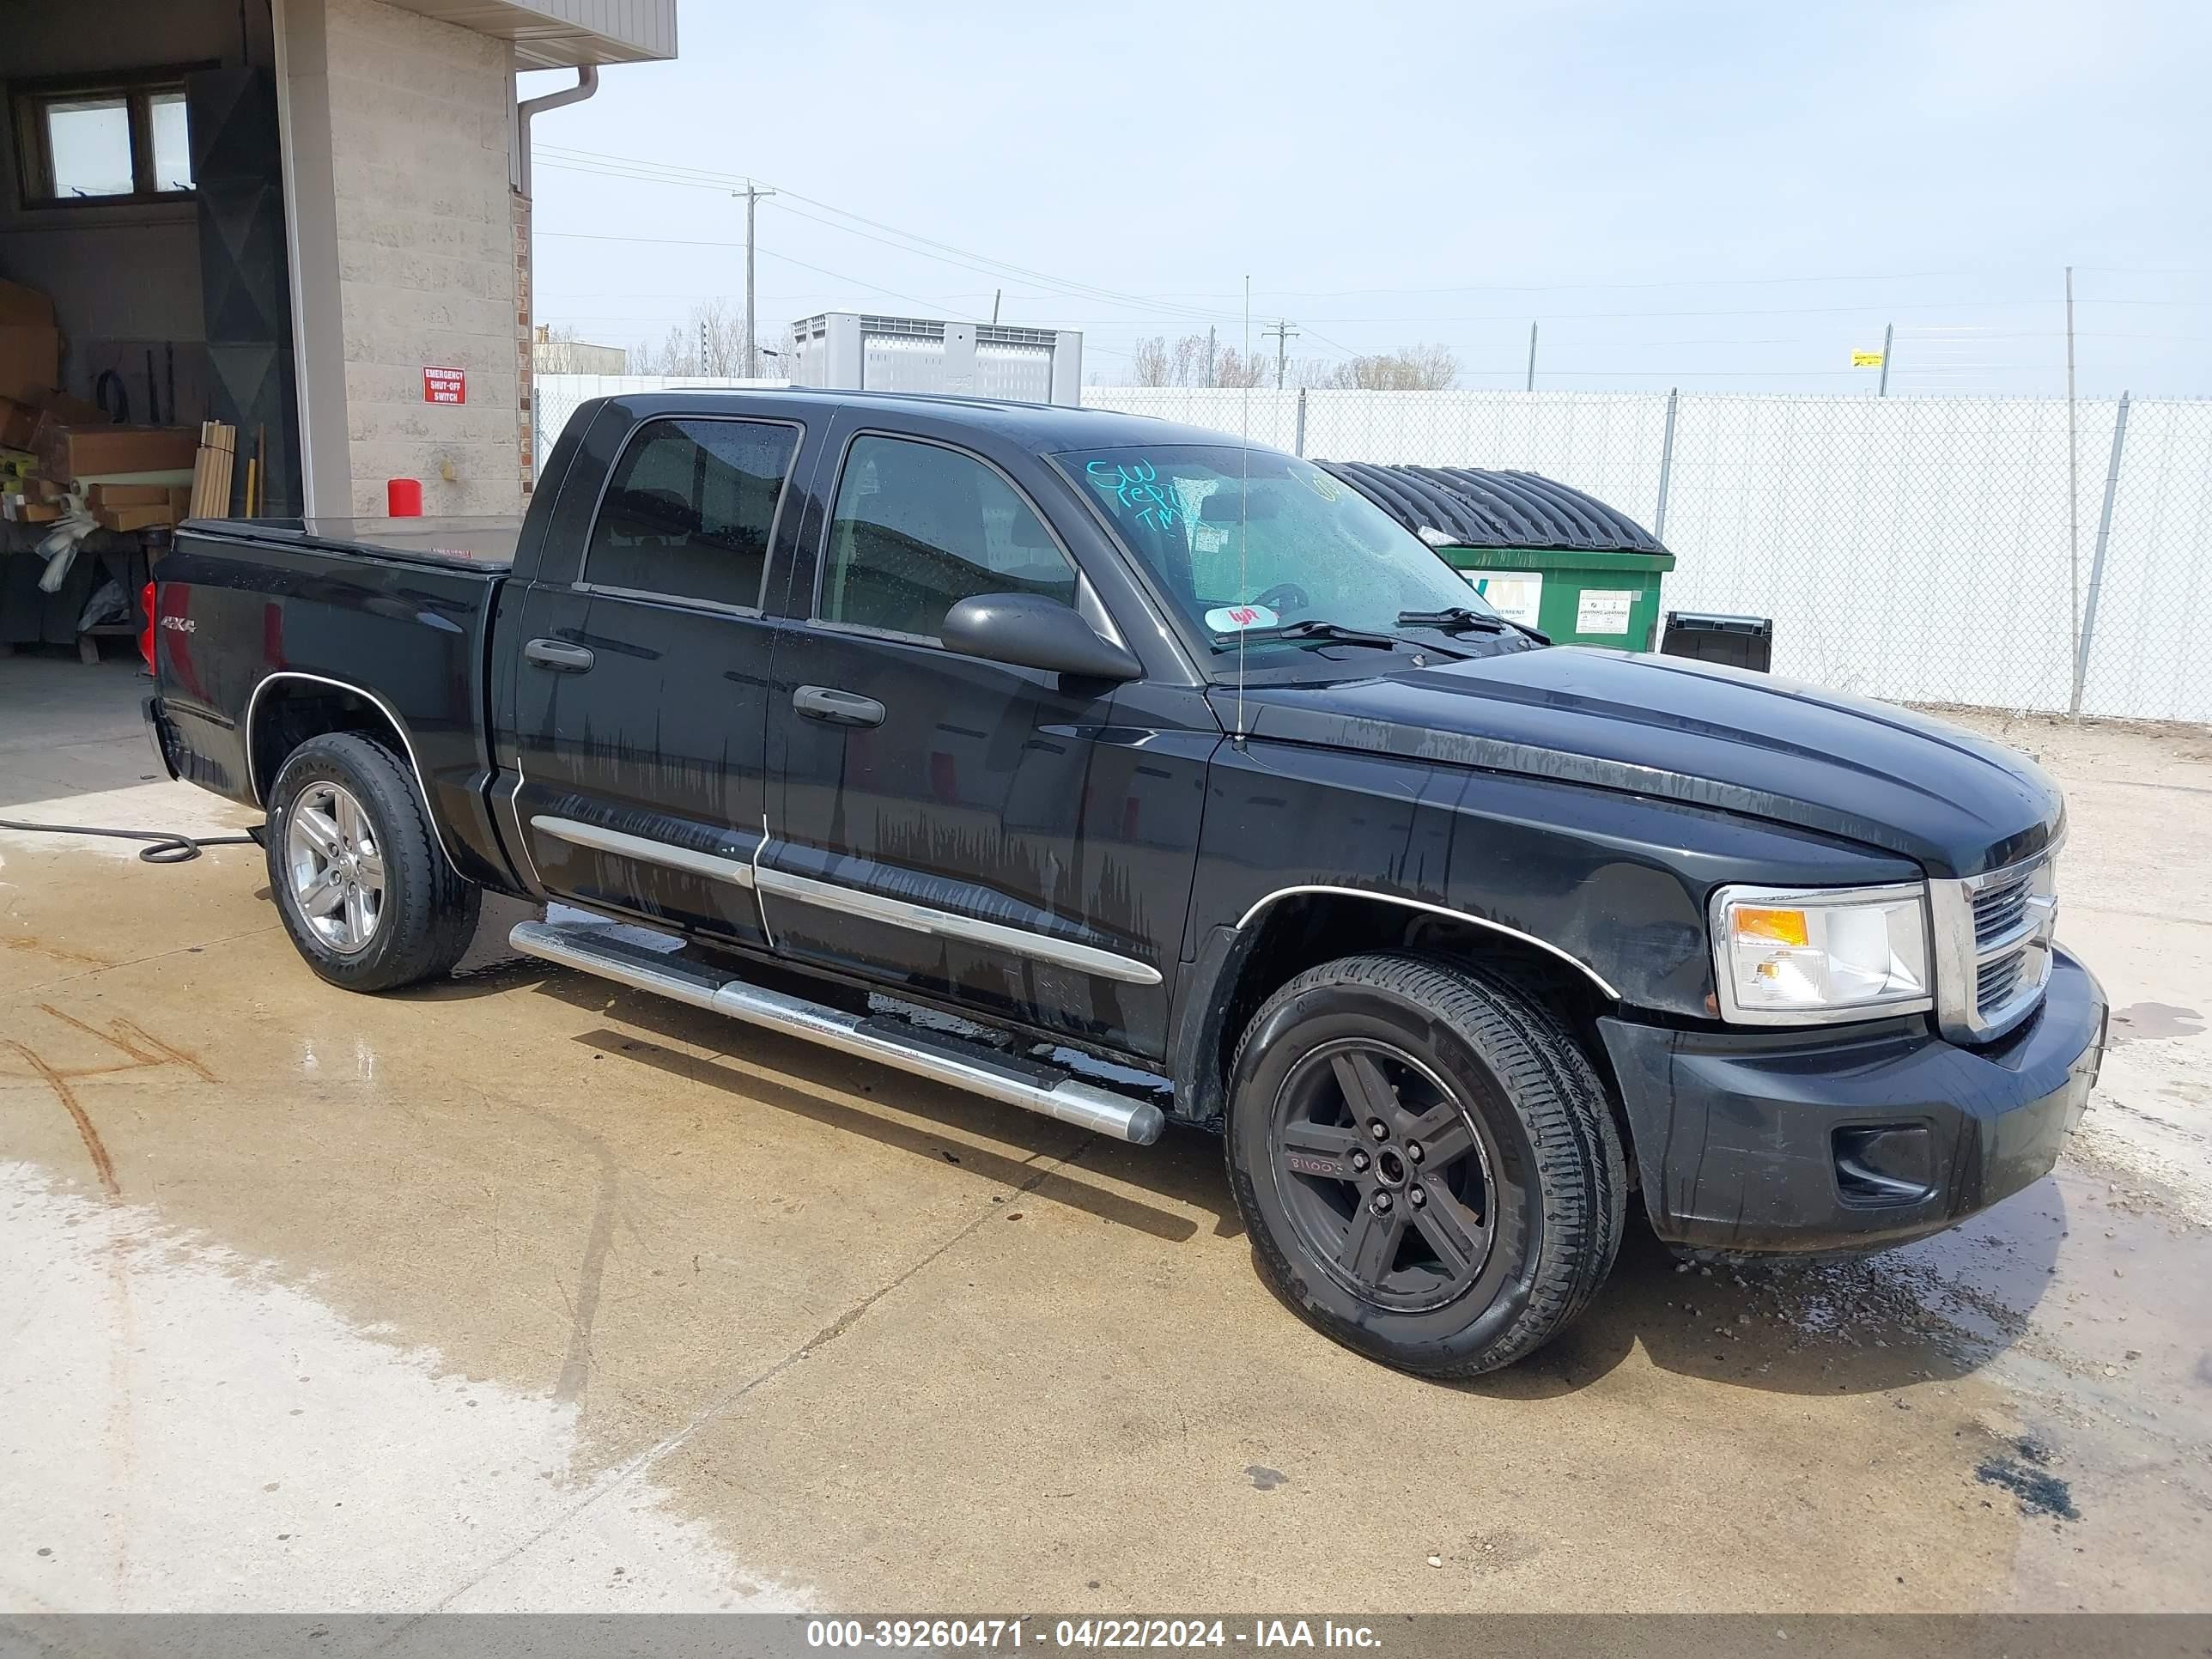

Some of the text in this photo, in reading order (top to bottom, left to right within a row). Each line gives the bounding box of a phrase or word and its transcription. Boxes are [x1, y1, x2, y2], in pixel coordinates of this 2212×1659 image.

[425, 369, 463, 380] EMERGENCY
[430, 380, 461, 391] SHUT-OFF
[434, 392, 459, 402] SWITCH
[1086, 458, 1156, 489] SW
